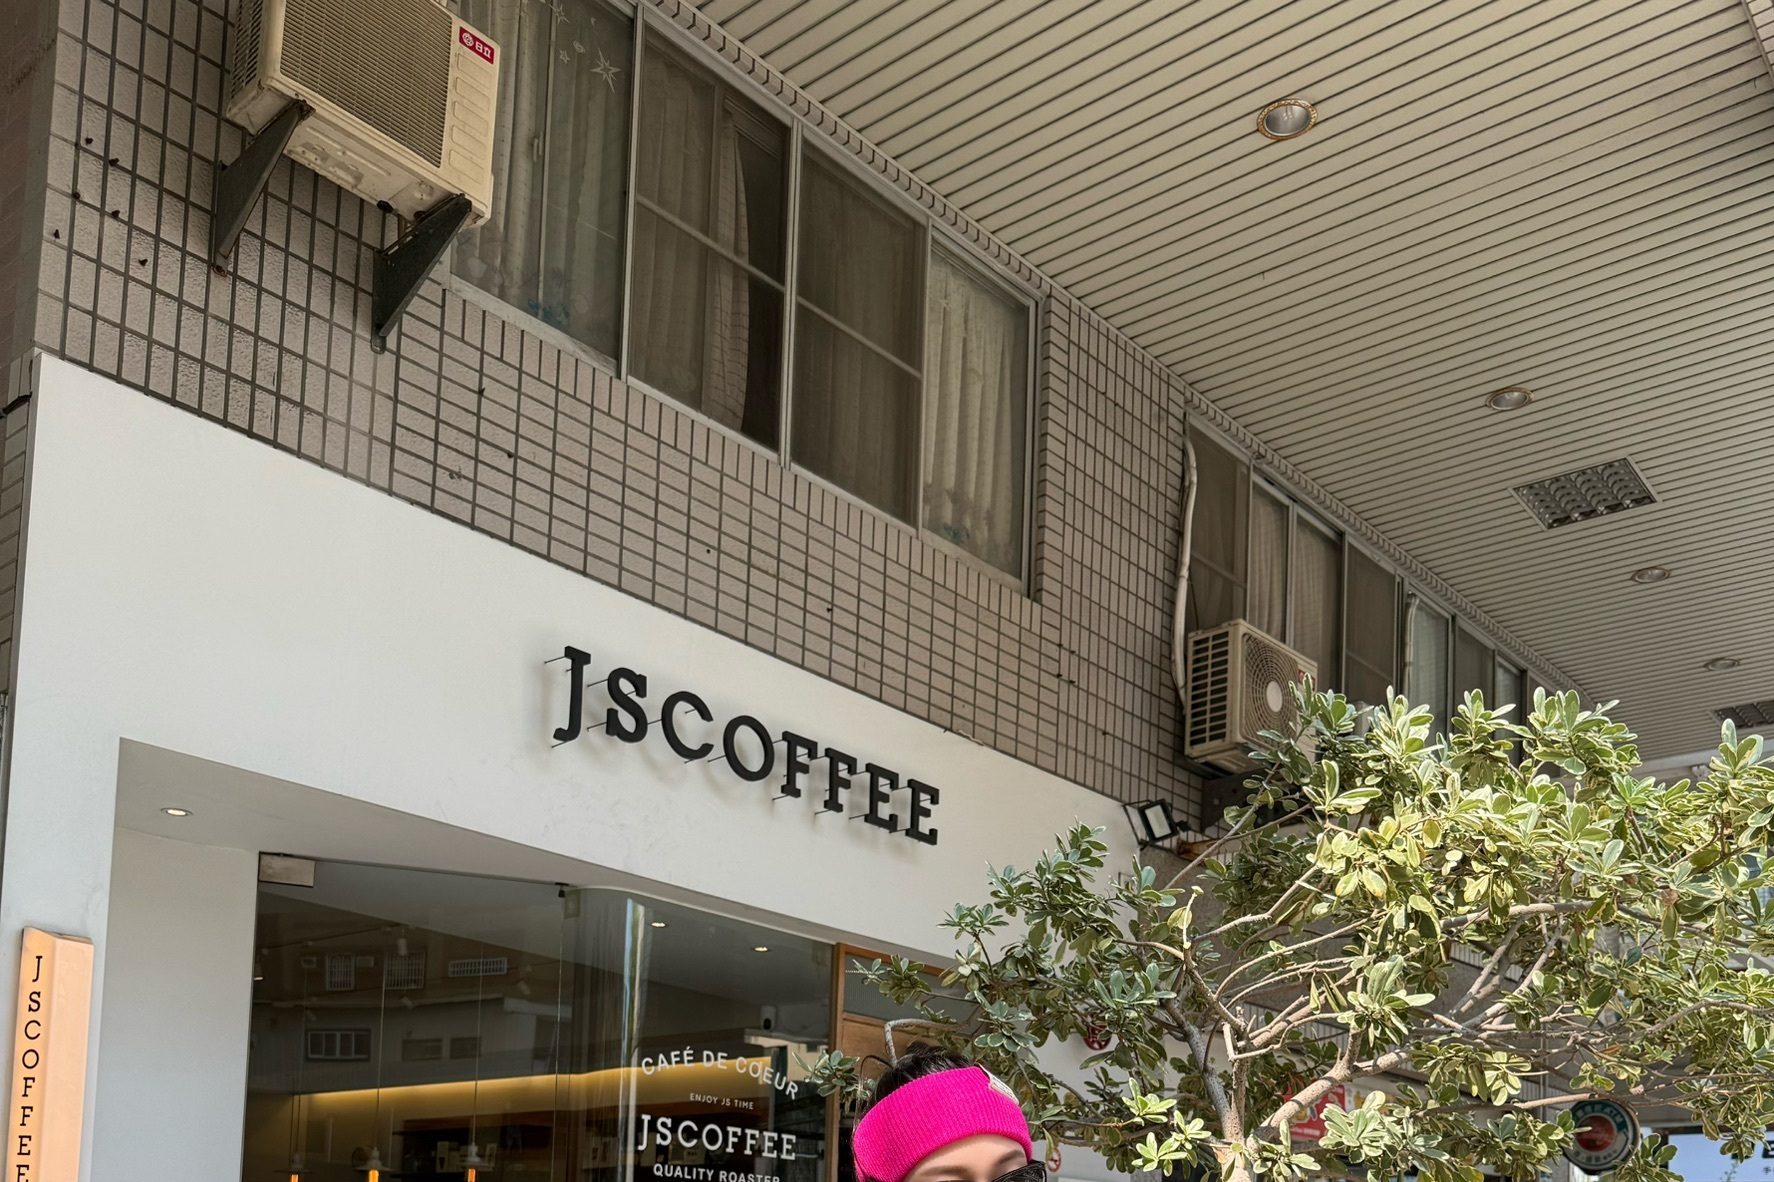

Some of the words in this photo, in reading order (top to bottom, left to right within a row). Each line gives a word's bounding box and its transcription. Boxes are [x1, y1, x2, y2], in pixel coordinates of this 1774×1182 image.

[553, 645, 940, 846] JSCOFFEE
[641, 1046, 695, 1075] CAFÉ
[703, 1050, 728, 1069] DE
[735, 1056, 799, 1100] COEUR
[690, 1092, 719, 1104] ENJOY
[721, 1098, 731, 1107] JS
[734, 1099, 754, 1110] TIME
[637, 1114, 797, 1161] JSCOFFEE
[653, 1163, 714, 1181] QUALITY
